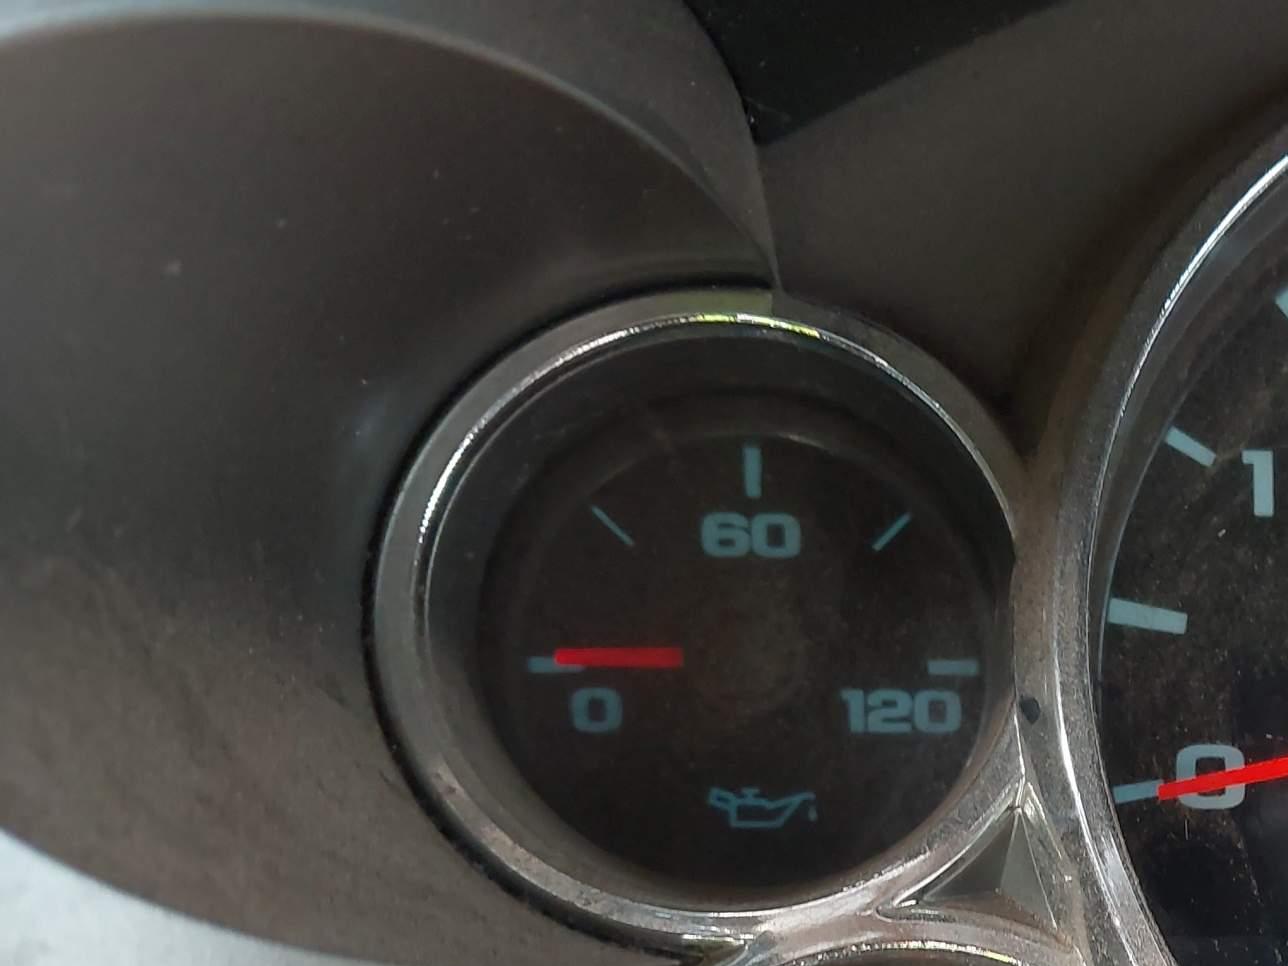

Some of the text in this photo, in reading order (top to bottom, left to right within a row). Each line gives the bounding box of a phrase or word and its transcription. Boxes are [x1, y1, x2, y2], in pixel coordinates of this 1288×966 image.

[1242, 450, 1274, 517] 1
[701, 512, 801, 558] 60
[570, 688, 623, 733] 0
[840, 689, 962, 734] 120
[1175, 744, 1246, 809] 0
